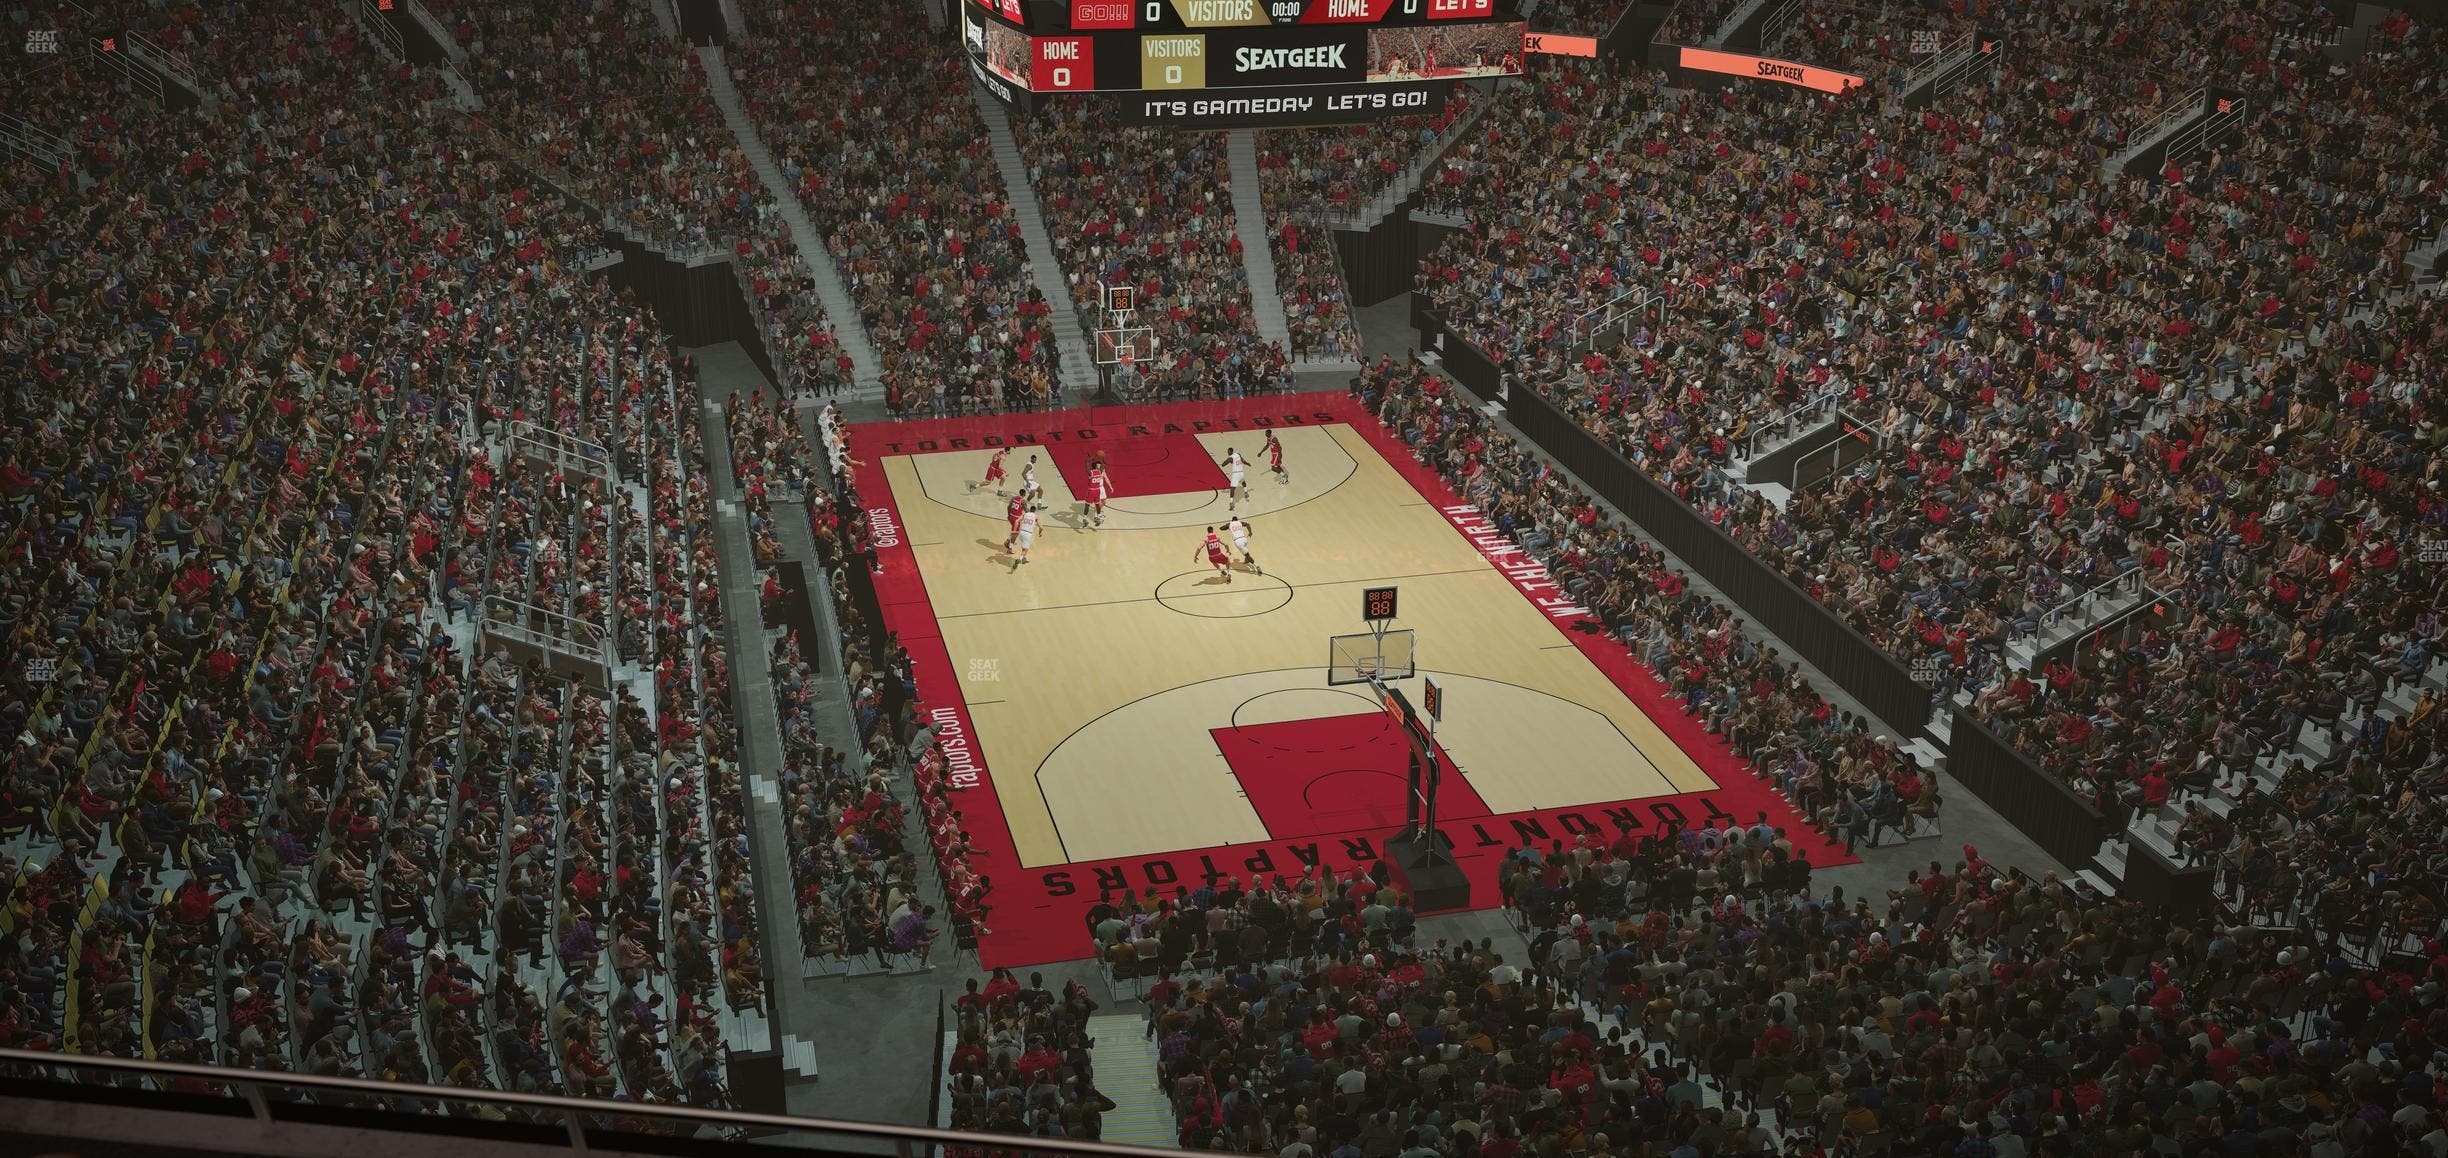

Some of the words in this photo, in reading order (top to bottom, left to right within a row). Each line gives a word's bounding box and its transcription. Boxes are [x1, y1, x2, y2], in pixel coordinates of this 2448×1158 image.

[1078, 4, 1129, 21] GO!!!
[1146, 2, 1161, 21] 0
[1187, 0, 1253, 21] VISITORS
[1272, 2, 1299, 17] 00:00
[1328, 0, 1369, 17] HOME
[1043, 41, 1079, 60] HOME
[1146, 39, 1201, 58] VISITORS
[1235, 43, 1347, 73] SEATGEEK
[1053, 68, 1071, 87] 0
[1165, 65, 1182, 84] 0
[1757, 61, 1805, 83] SEATGEEK
[1145, 101, 1187, 117] IT'S
[1193, 96, 1313, 116] GAMEDAY
[1327, 93, 1387, 110] LET'S
[1392, 91, 1428, 107] GO!
[885, 429, 1098, 453] TORONTO
[1128, 412, 1334, 437] RAPTORS
[868, 507, 900, 548] @raptors
[1500, 559, 1559, 591] THE
[1371, 601, 1390, 616] 88
[931, 707, 982, 789] raptors.com
[1042, 837, 1378, 897] RAPTORS
